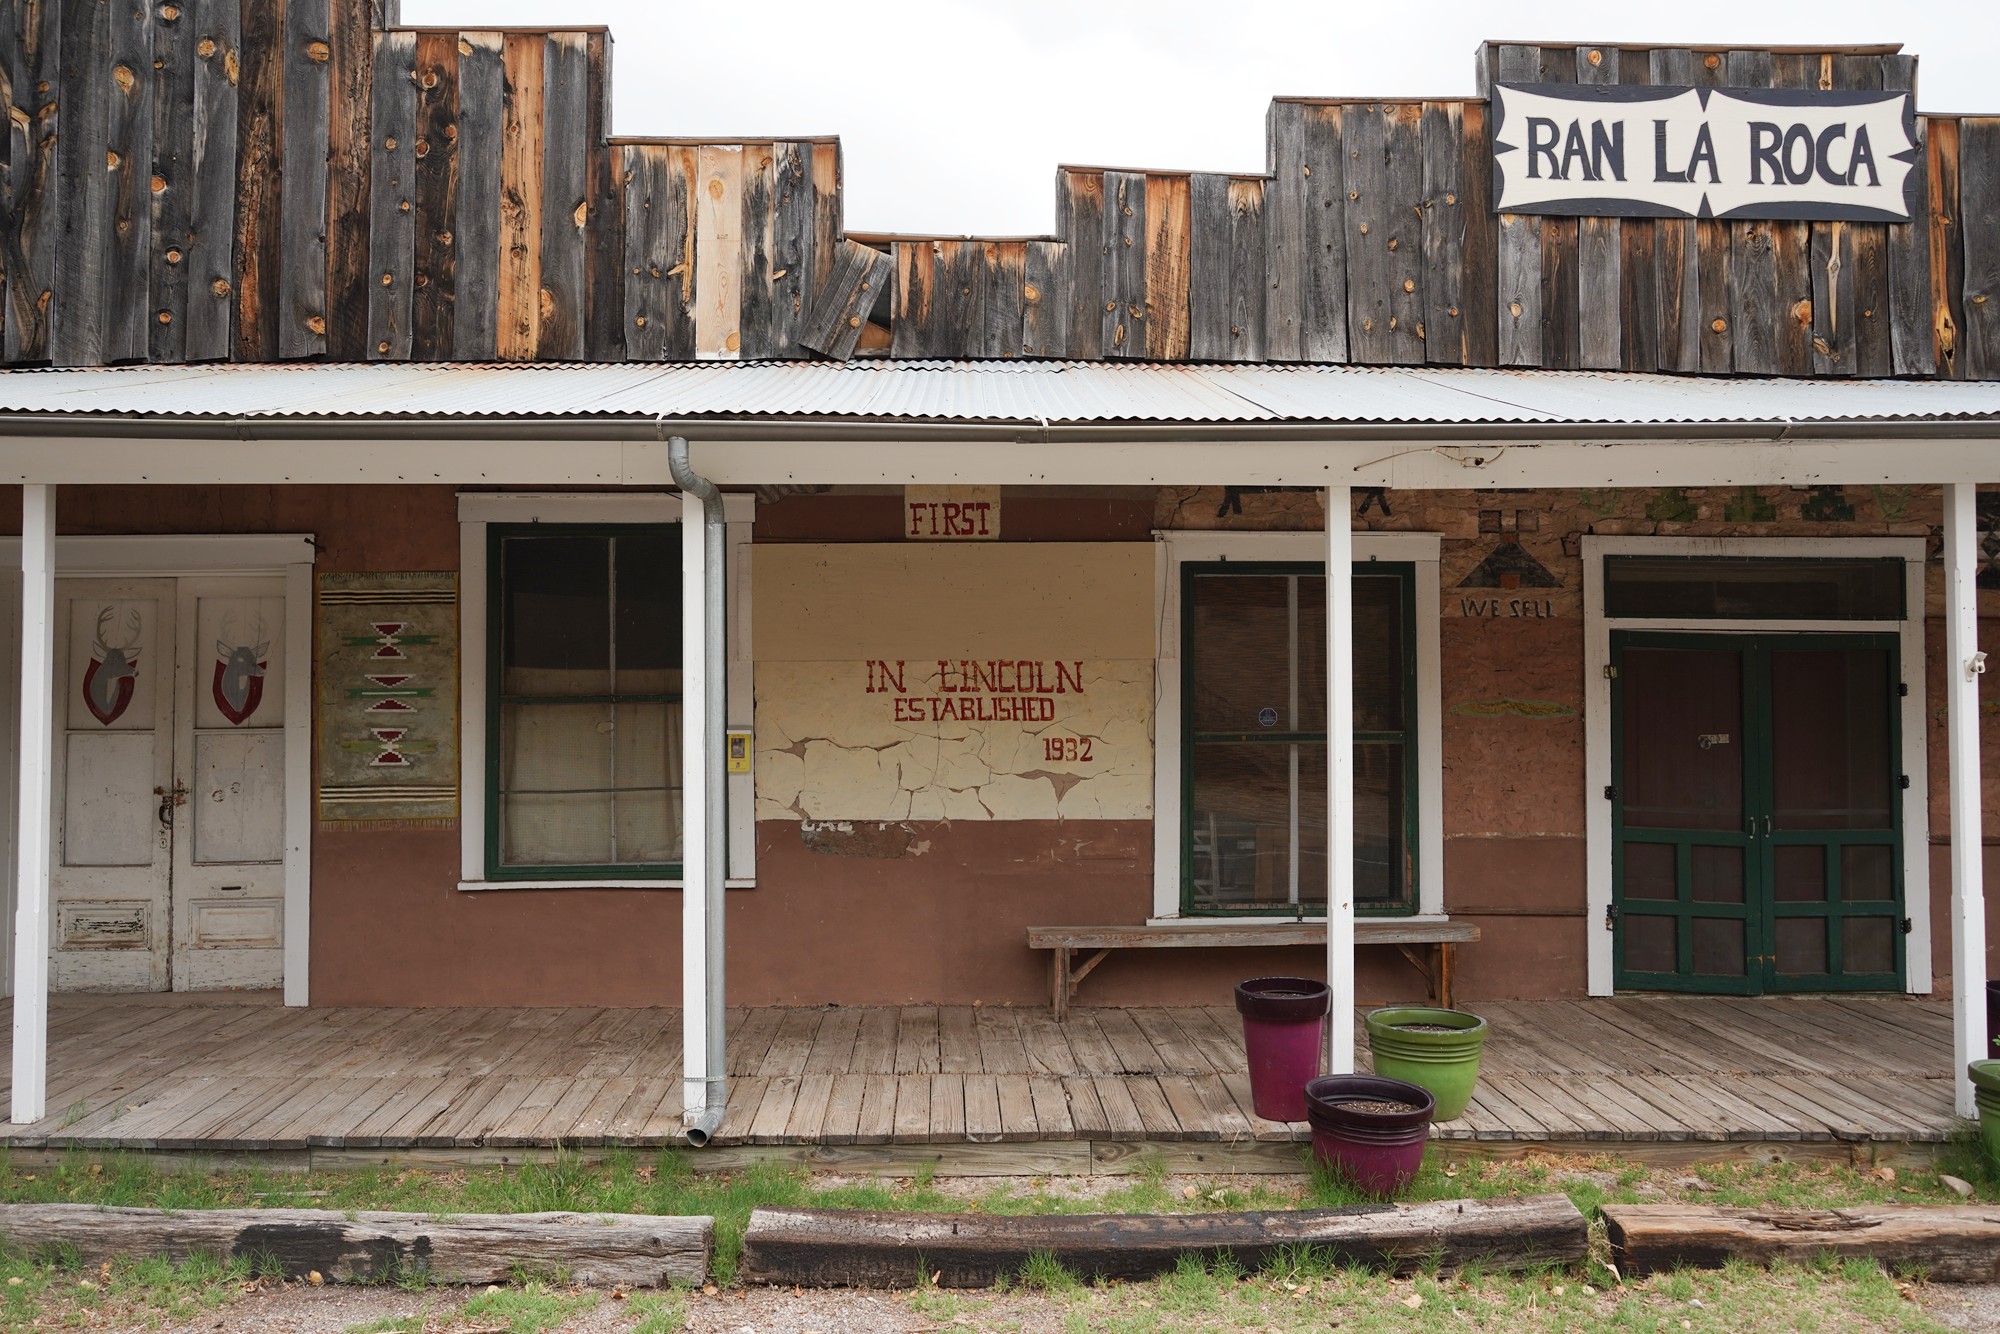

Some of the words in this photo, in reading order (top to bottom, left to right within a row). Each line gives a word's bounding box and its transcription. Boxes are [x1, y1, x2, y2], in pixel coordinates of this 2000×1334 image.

[1525, 116, 1627, 182] RAN
[1653, 119, 1722, 184] LA
[1747, 122, 1882, 186] ROCA
[909, 502, 991, 536] FIRST
[1460, 599, 1500, 618] WE
[1509, 599, 1558, 618] SELL
[866, 660, 907, 693] IN
[938, 660, 1084, 694] LINCOLN
[894, 697, 1055, 721] ESTABLISHED
[1042, 737, 1094, 762] 1932
